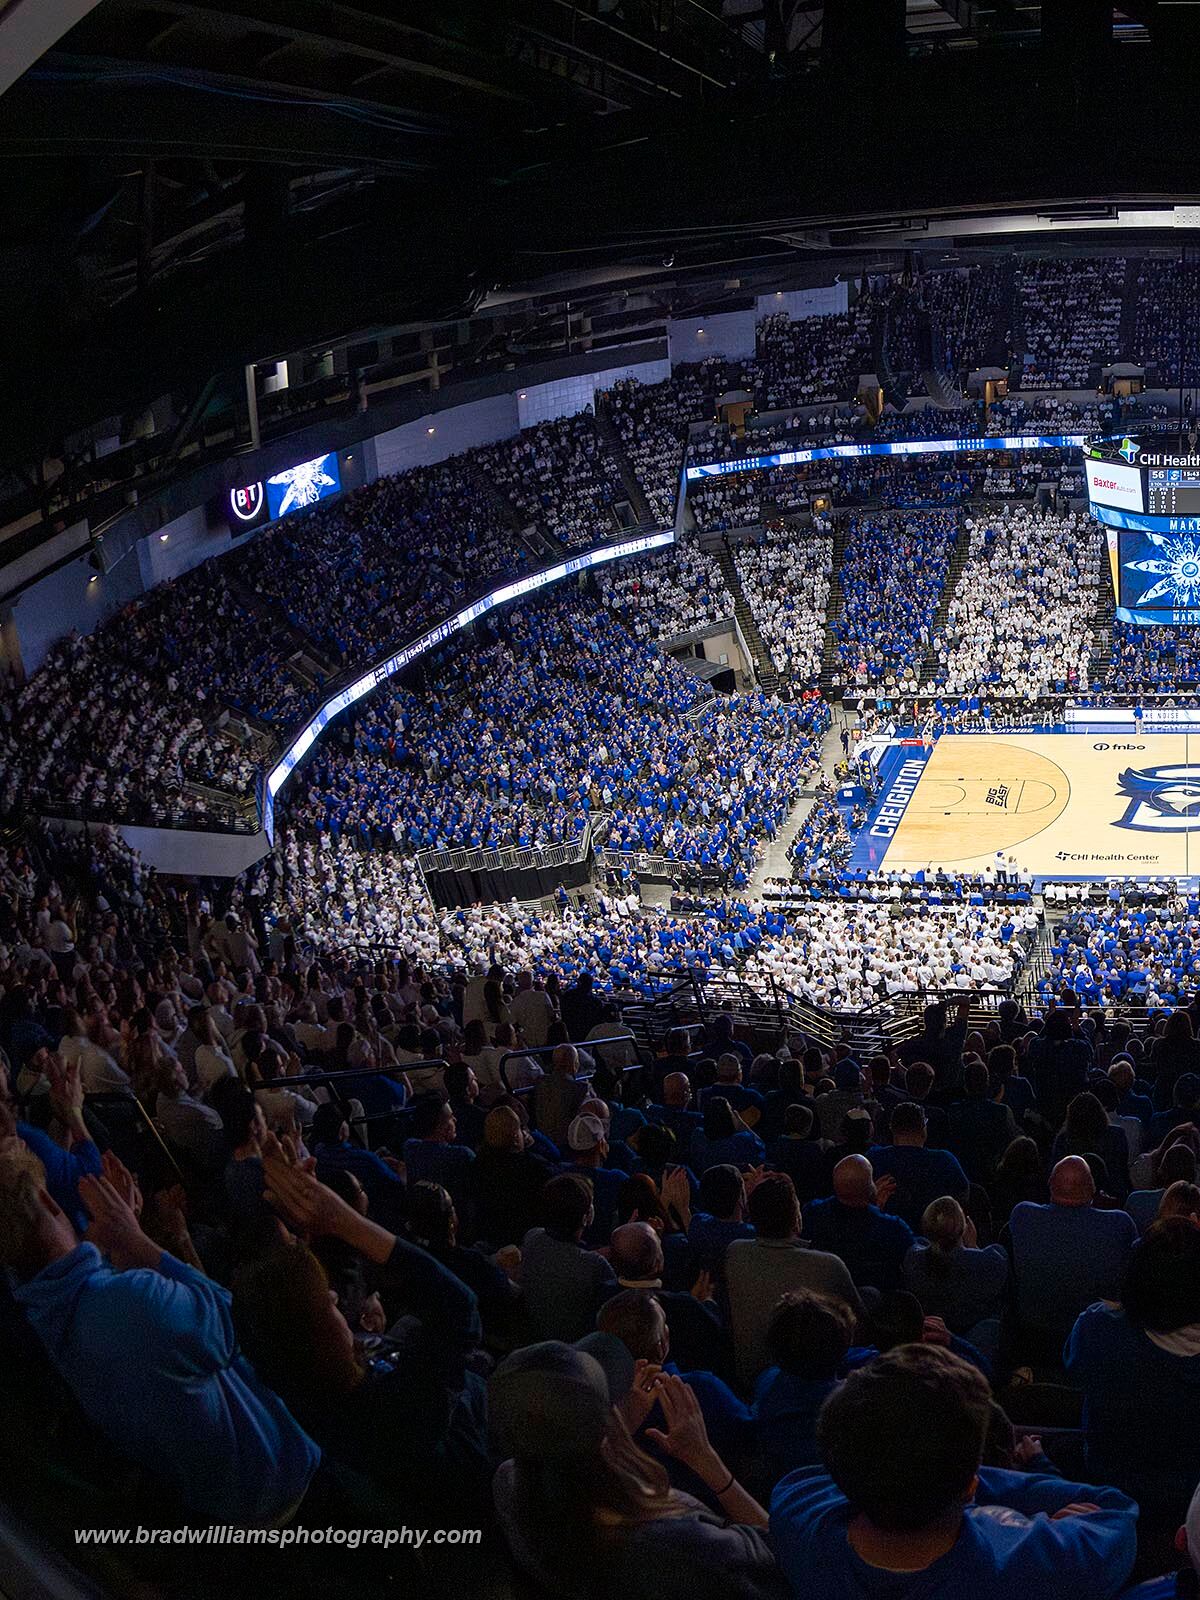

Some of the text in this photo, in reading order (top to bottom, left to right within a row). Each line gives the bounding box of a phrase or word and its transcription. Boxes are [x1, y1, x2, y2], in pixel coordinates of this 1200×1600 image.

[1139, 453, 1160, 465] CHI
[1093, 477, 1117, 490] Baxter
[1172, 613, 1199, 621] MAKE
[1112, 743, 1146, 751] fnbo
[870, 759, 927, 838] CREIGHTON
[985, 788, 998, 805] BIG
[994, 784, 1008, 807] EAST
